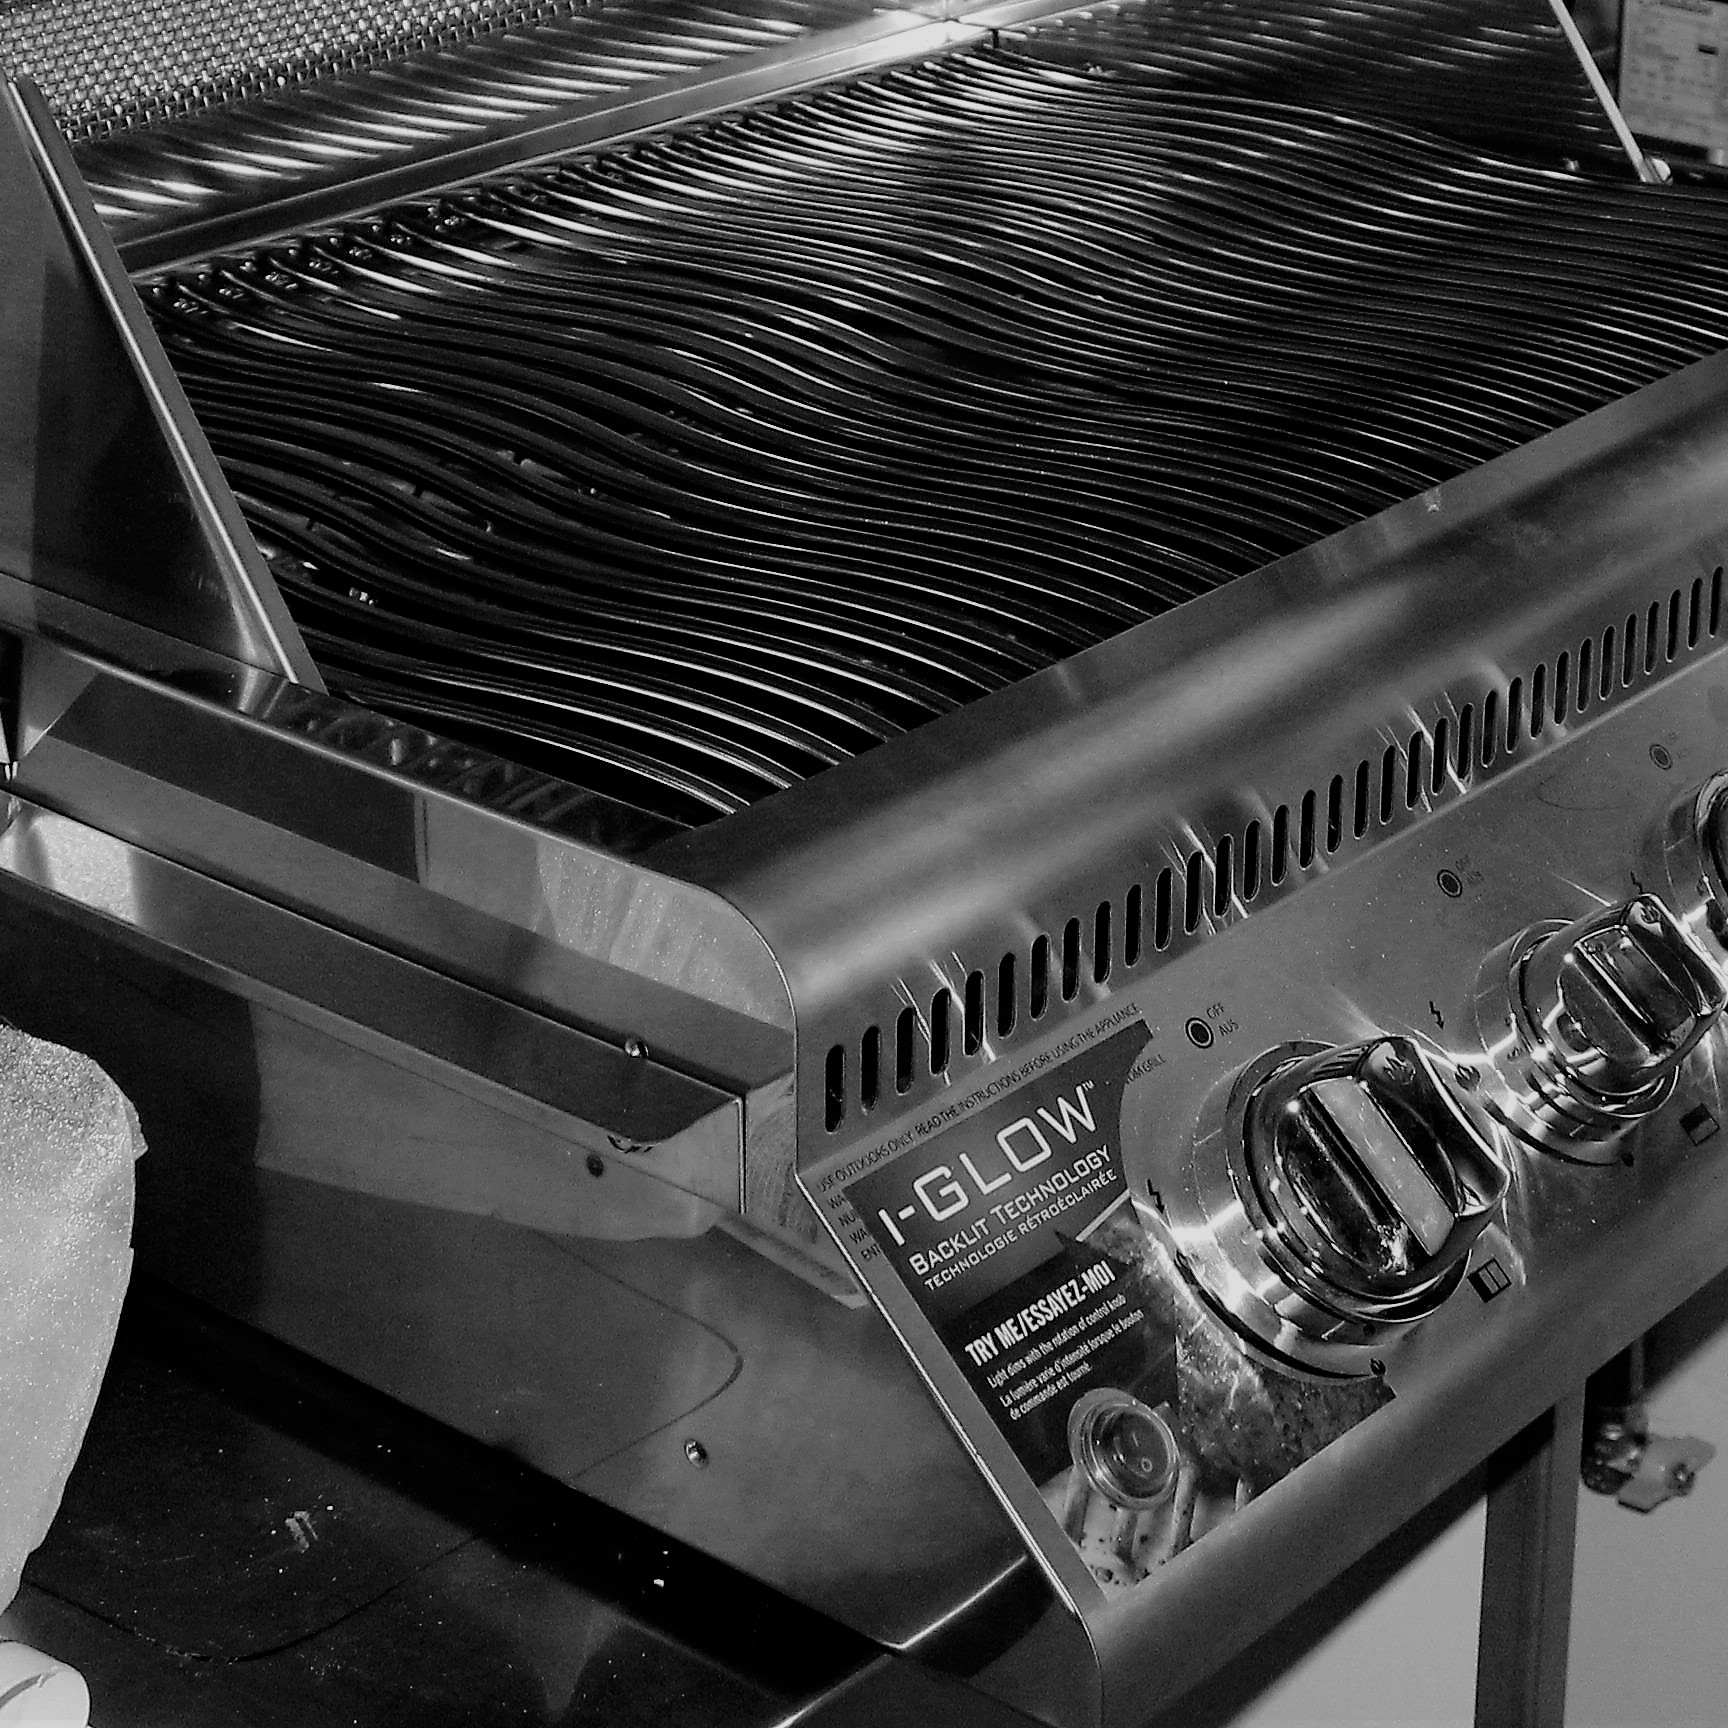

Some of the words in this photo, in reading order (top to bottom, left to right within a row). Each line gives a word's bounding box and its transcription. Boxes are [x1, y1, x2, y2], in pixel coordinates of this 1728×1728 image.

[913, 1113, 943, 1137] READ
[939, 1104, 959, 1122] THE
[909, 1217, 990, 1276] BACKLIT
[989, 1144, 1112, 1225] TECHNOLOGY
[924, 1229, 1018, 1291] TECHNOLOGIE
[1019, 1168, 1118, 1235] RÉTROÉCLAIRÉE
[965, 1332, 999, 1366] TRY
[994, 1260, 1116, 1349] ME/ESSAYEZ-MOI
[987, 1369, 1009, 1388] Light
[1025, 1348, 1042, 1366] with
[1039, 1342, 1053, 1355] the
[1052, 1324, 1080, 1347] rotation
[1078, 1317, 1087, 1331] of
[1086, 1302, 1109, 1326] control
[1107, 1293, 1126, 1311] knob
[1000, 1390, 1012, 1407] La
[1036, 1366, 1056, 1384] varie
[1088, 1328, 1115, 1354] lorsque
[1112, 1322, 1122, 1334] le
[1009, 1407, 1022, 1420] de
[1020, 1383, 1058, 1414] commande
[1056, 1375, 1069, 1390] est
